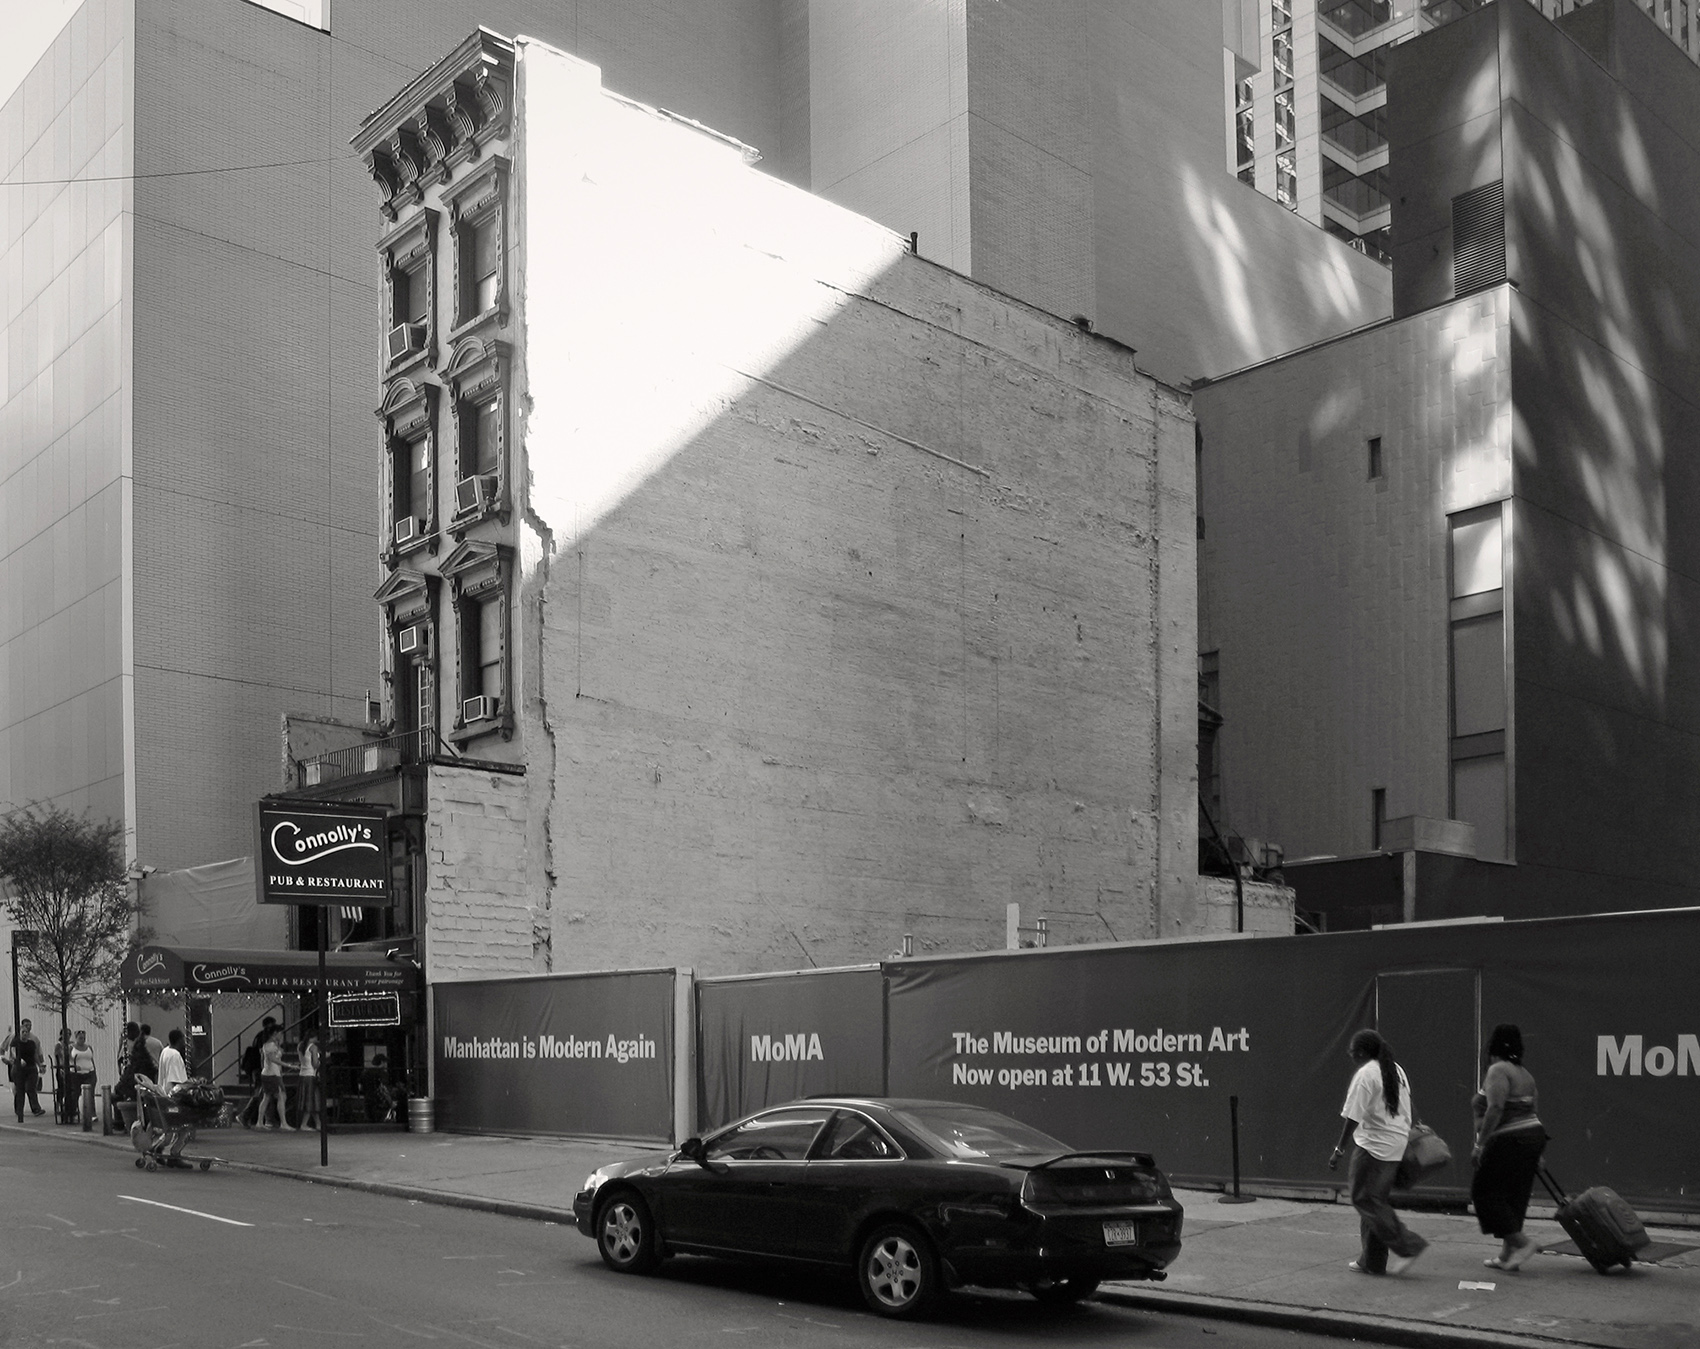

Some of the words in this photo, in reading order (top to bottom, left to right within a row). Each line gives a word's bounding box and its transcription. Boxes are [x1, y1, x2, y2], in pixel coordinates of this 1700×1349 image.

[271, 821, 380, 866] Connolly's
[269, 875, 294, 886] PUB
[295, 876, 305, 886] &
[307, 877, 385, 889] RESTAURANT
[192, 964, 251, 984] Connolly's
[258, 978, 278, 986] PUB
[281, 978, 289, 986] &
[292, 978, 360, 987] RESTURANT
[444, 1036, 519, 1059] Manhattan
[523, 1036, 536, 1059] is
[539, 1035, 602, 1059] Modern
[605, 1033, 656, 1063] Again
[750, 1033, 824, 1062] MoMA
[952, 1032, 989, 1054] The
[993, 1031, 1082, 1054] Museum
[1086, 1029, 1108, 1053] of
[1113, 1028, 1203, 1053] Modern
[1208, 1027, 1250, 1052] Art
[952, 1063, 994, 1085] Now
[998, 1066, 1047, 1090] open
[1052, 1064, 1074, 1086] at
[1078, 1063, 1101, 1086] 11
[1106, 1062, 1135, 1086] W.
[1140, 1062, 1171, 1087] 53
[1176, 1062, 1209, 1087] St.
